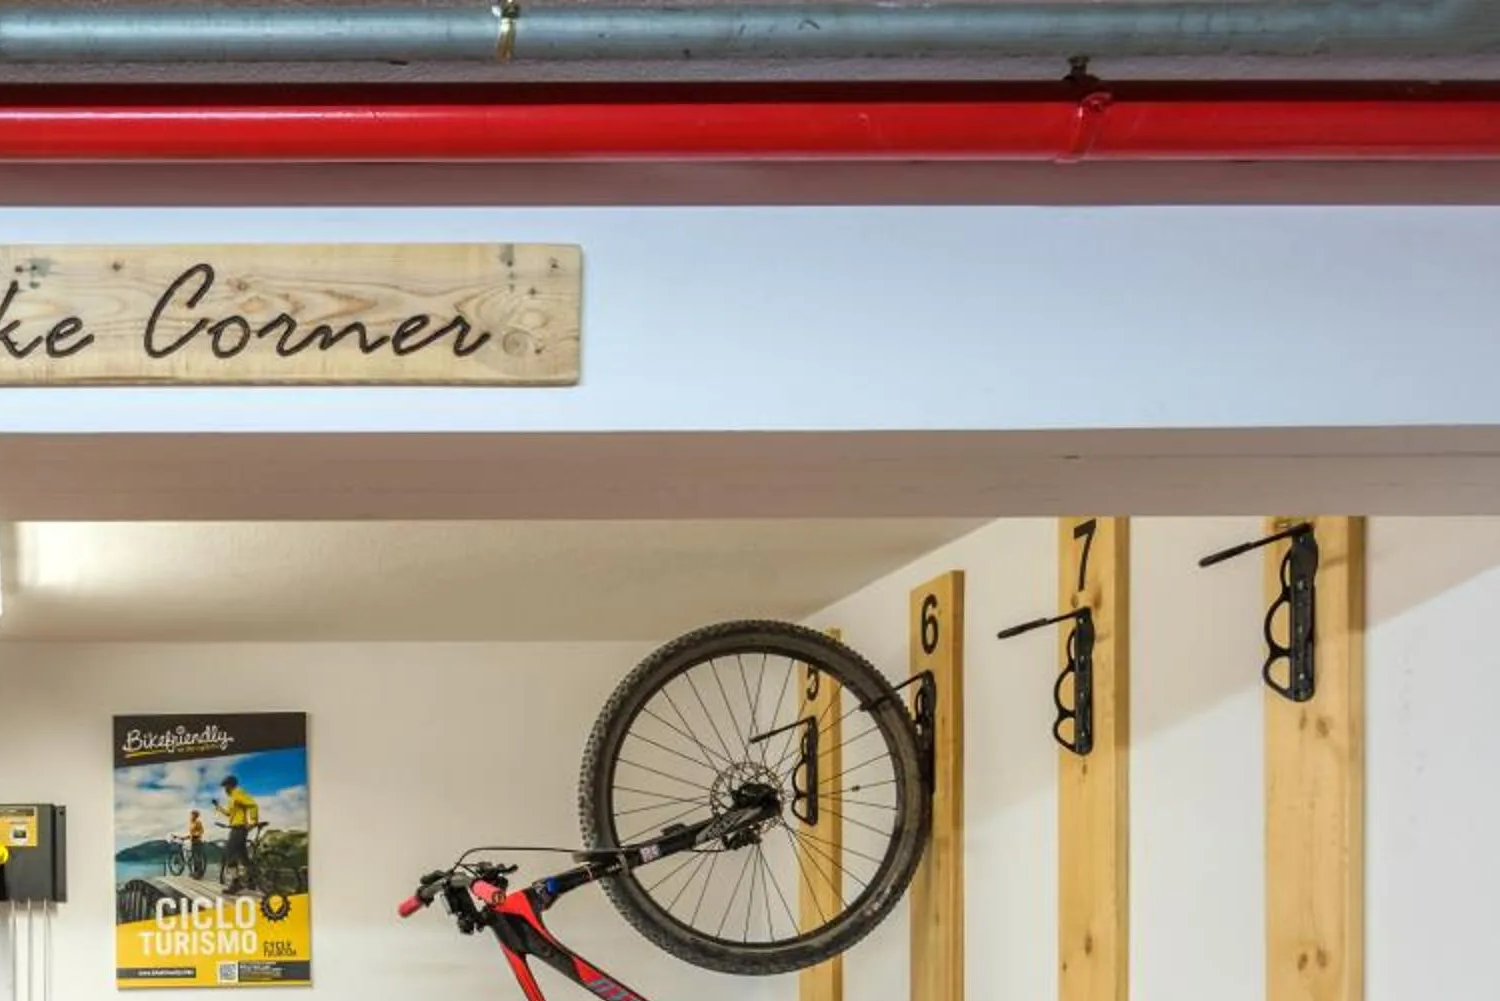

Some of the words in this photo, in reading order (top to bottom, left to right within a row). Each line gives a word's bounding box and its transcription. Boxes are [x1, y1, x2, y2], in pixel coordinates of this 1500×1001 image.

[142, 263, 493, 360] Corner
[1073, 517, 1097, 593] 7
[920, 594, 940, 655] 6
[122, 724, 234, 752] Bikefriendly
[155, 895, 257, 931] CICLO
[138, 929, 258, 957] TURISMO
